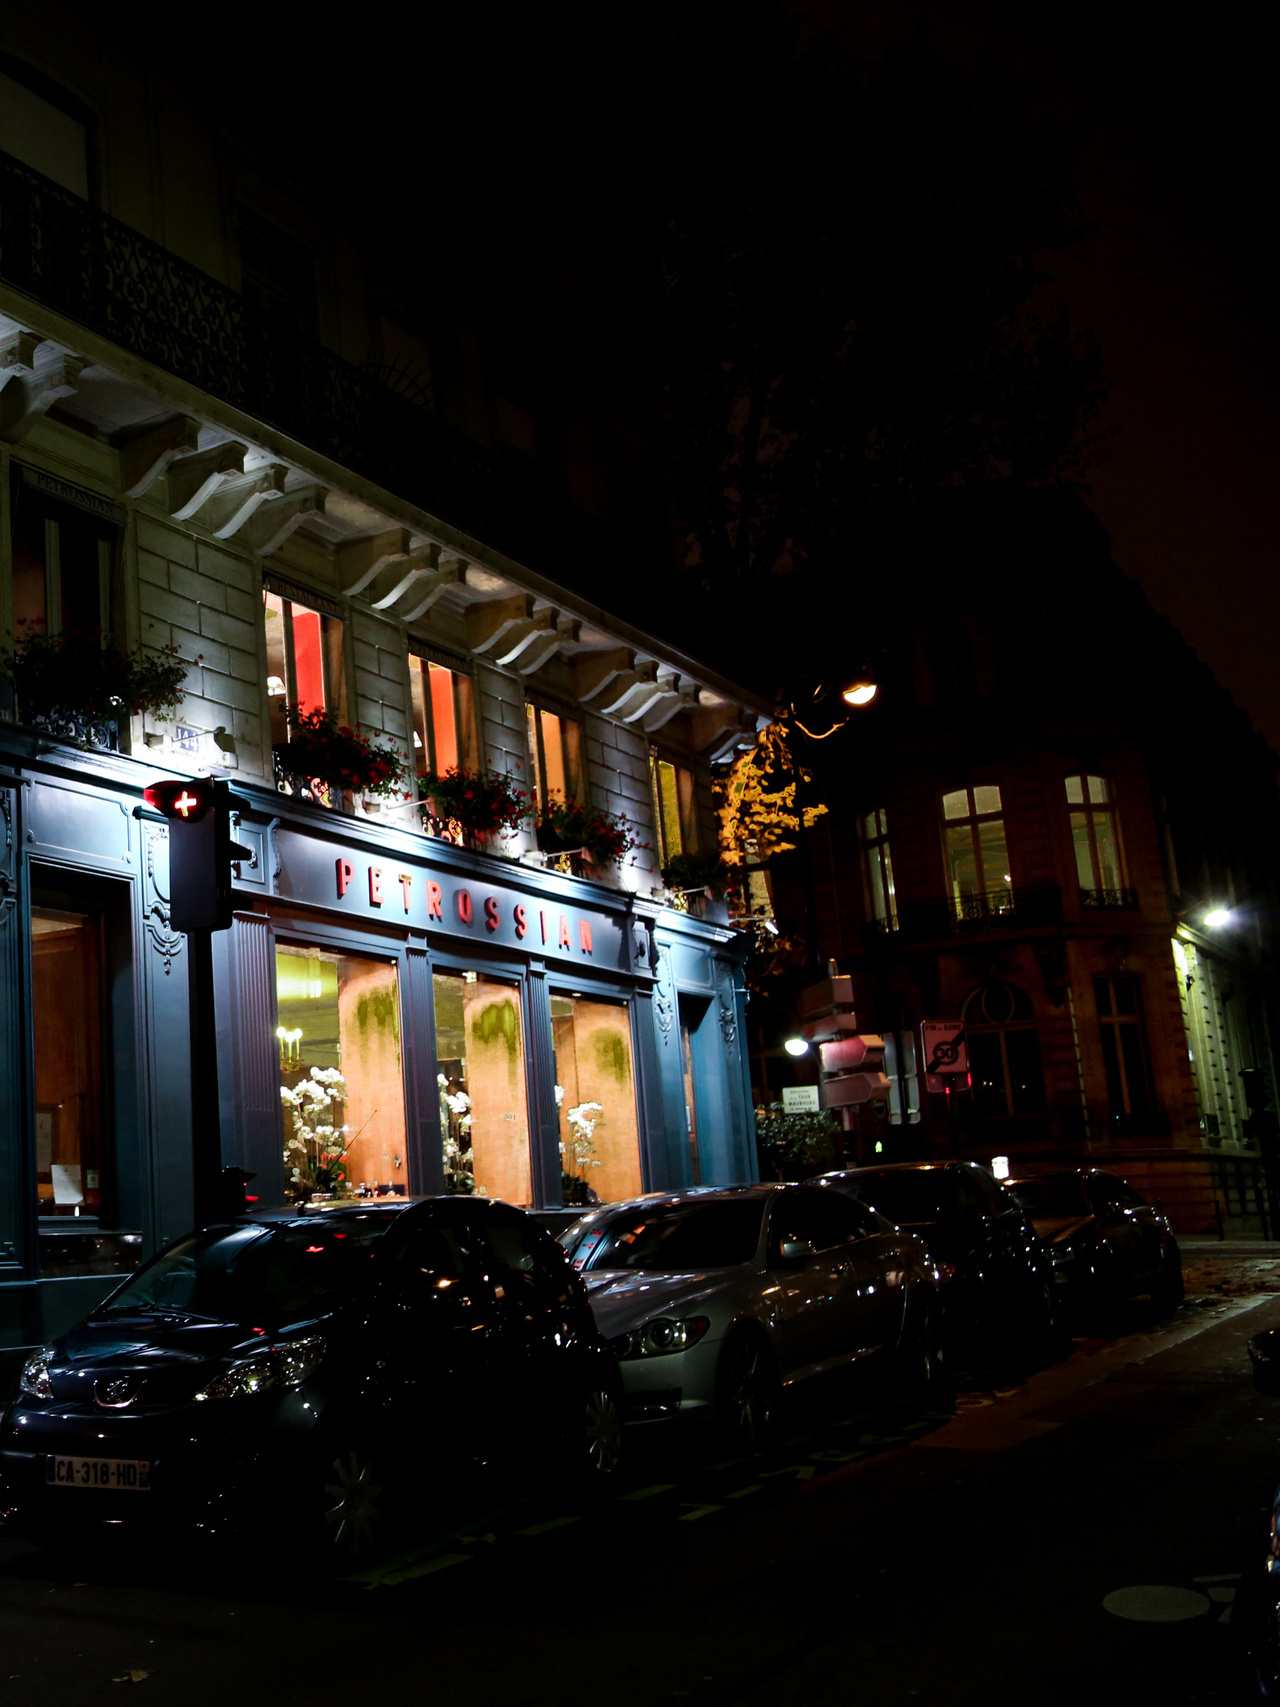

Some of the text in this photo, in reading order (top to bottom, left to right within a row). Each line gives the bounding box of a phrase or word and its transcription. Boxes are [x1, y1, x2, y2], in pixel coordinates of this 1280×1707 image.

[37, 473, 114, 515] PETROSSIAN
[335, 857, 594, 956] PETROSSIAN
[938, 1047, 955, 1059] 30
[56, 1460, 138, 1487] CA-318-HD
